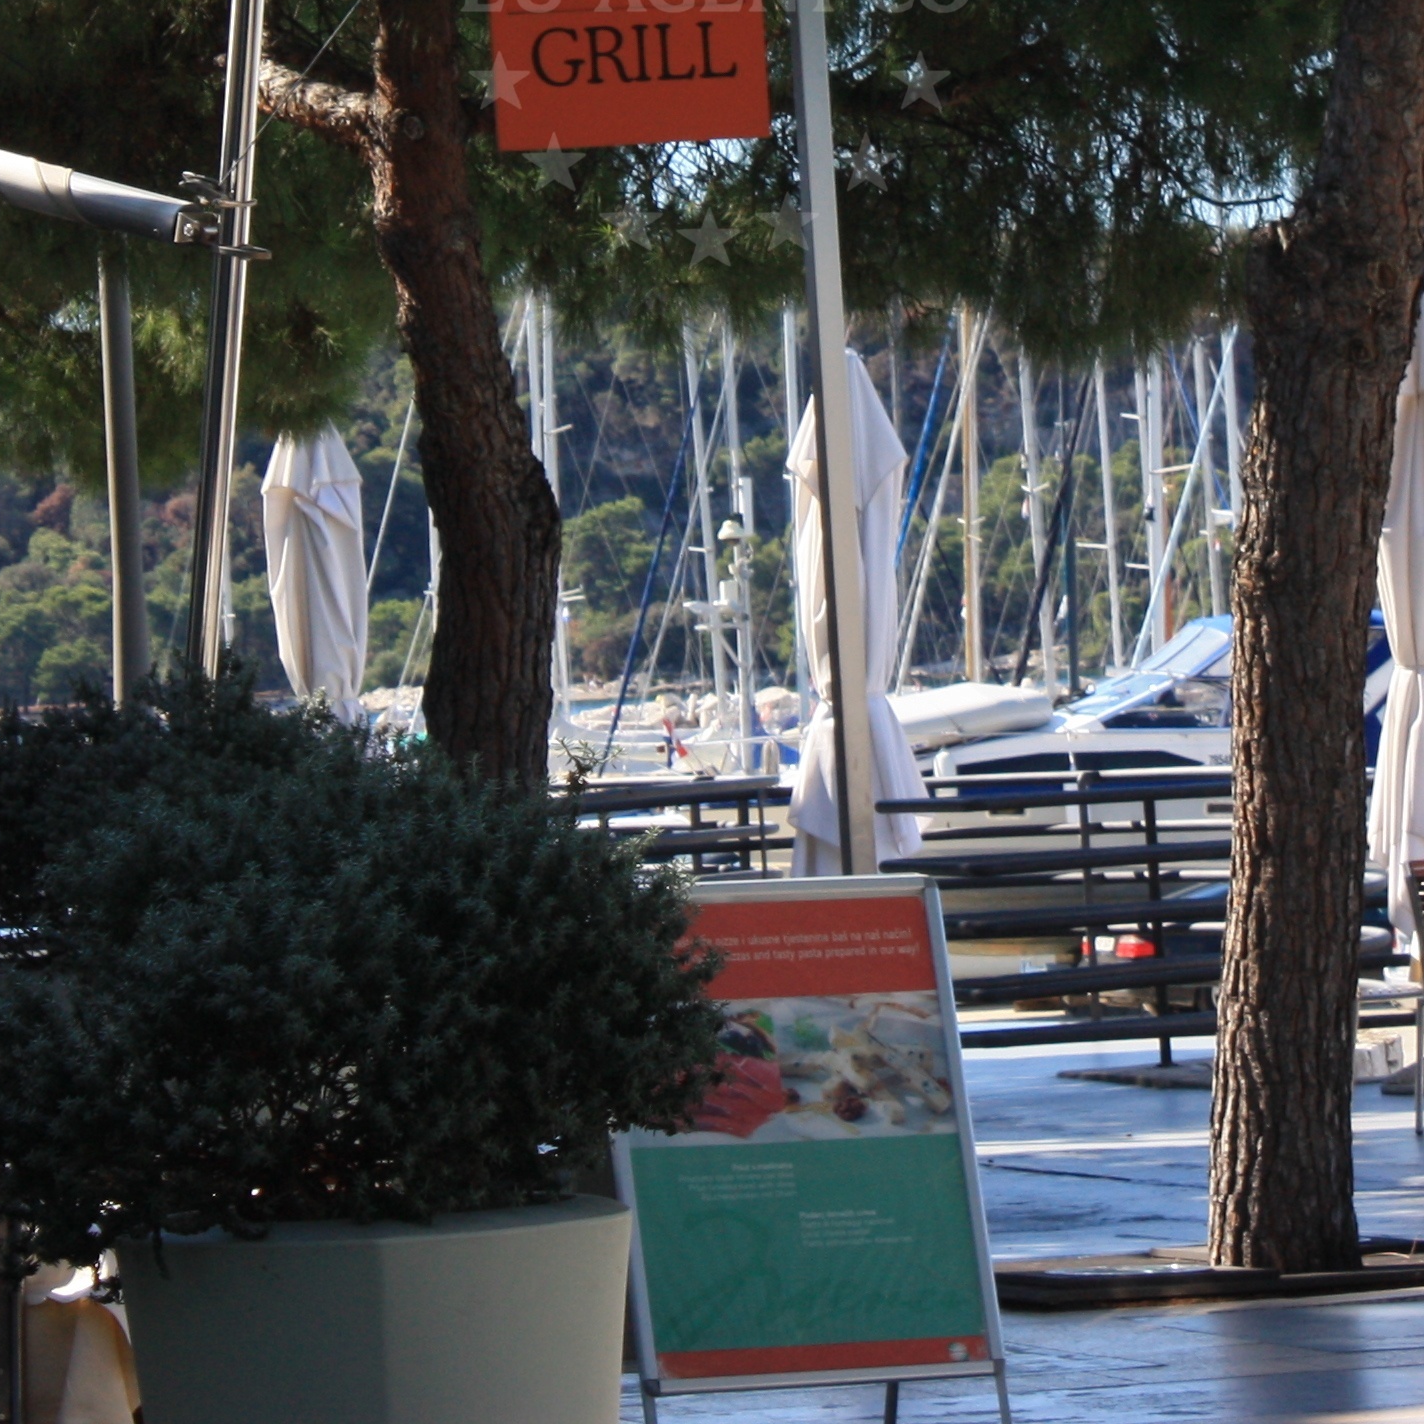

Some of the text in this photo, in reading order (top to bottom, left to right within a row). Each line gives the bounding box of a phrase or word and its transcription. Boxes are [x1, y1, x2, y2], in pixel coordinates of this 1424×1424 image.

[531, 21, 737, 87] GRILL
[753, 949, 771, 961] and
[772, 948, 795, 963] tasty
[797, 947, 823, 960] pasta
[824, 944, 866, 959] prepared
[867, 944, 878, 956] in
[879, 944, 896, 955] our
